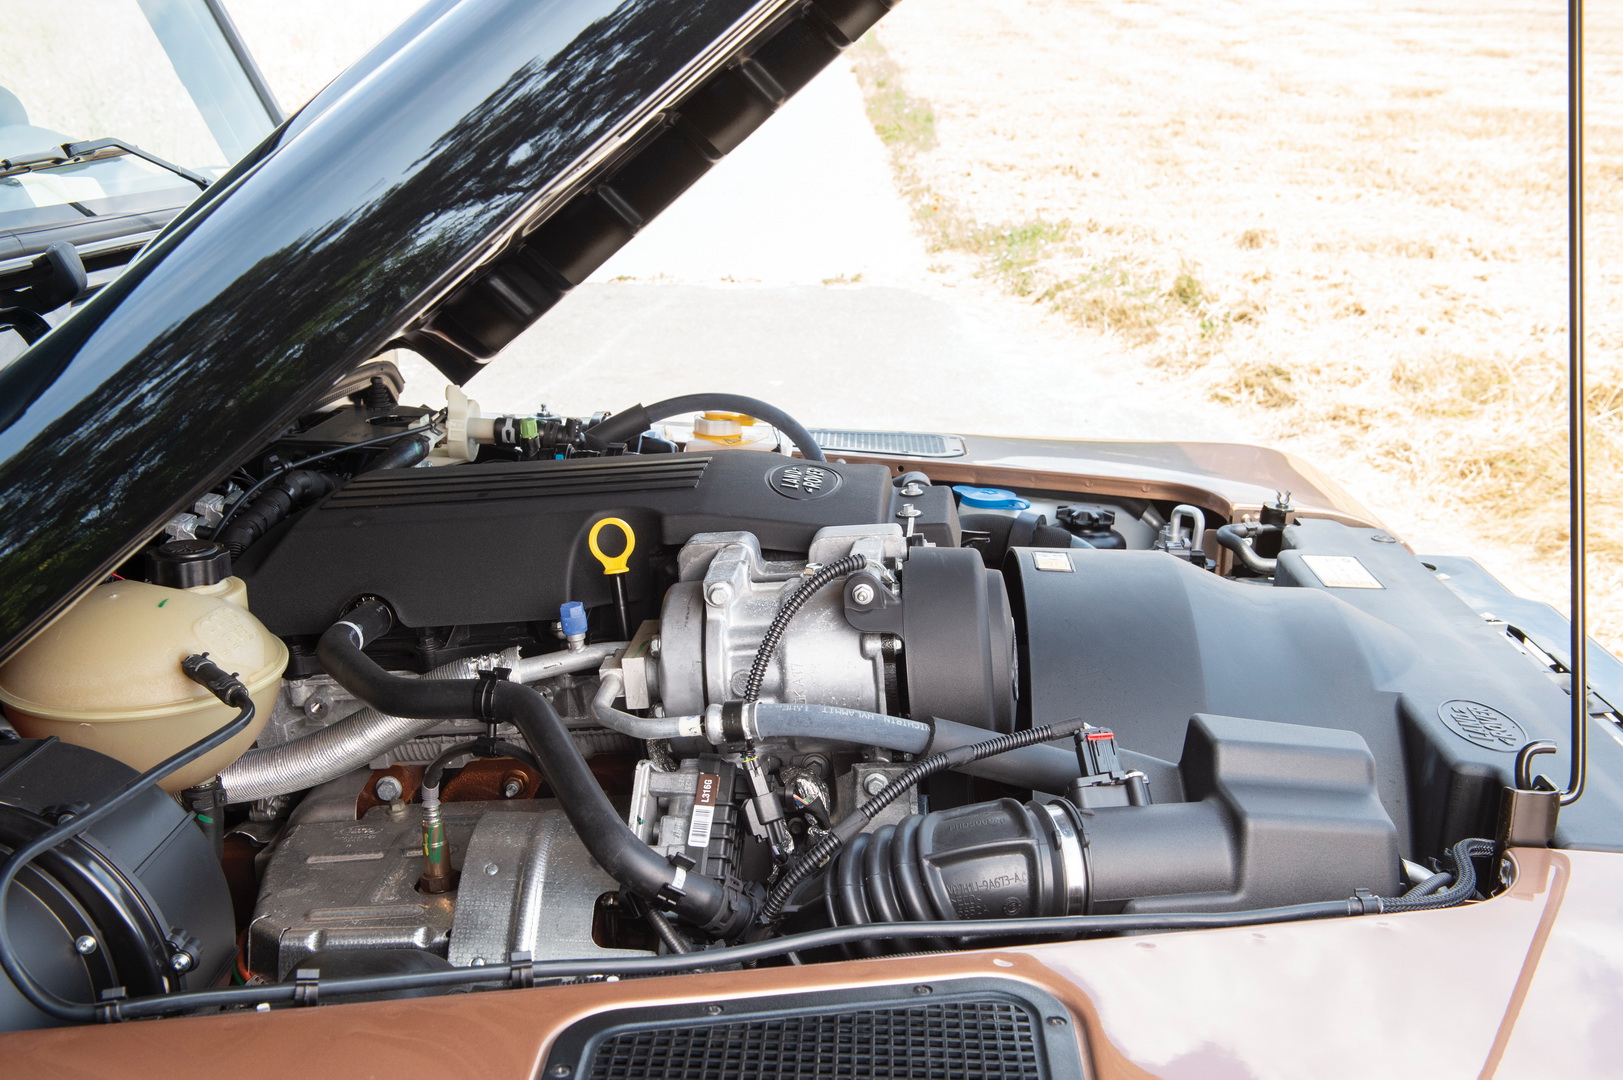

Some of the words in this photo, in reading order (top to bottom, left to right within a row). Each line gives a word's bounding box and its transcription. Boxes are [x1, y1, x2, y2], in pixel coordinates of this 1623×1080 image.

[781, 467, 802, 489] LAND
[803, 467, 826, 491] ROVER
[700, 779, 713, 803] L316G
